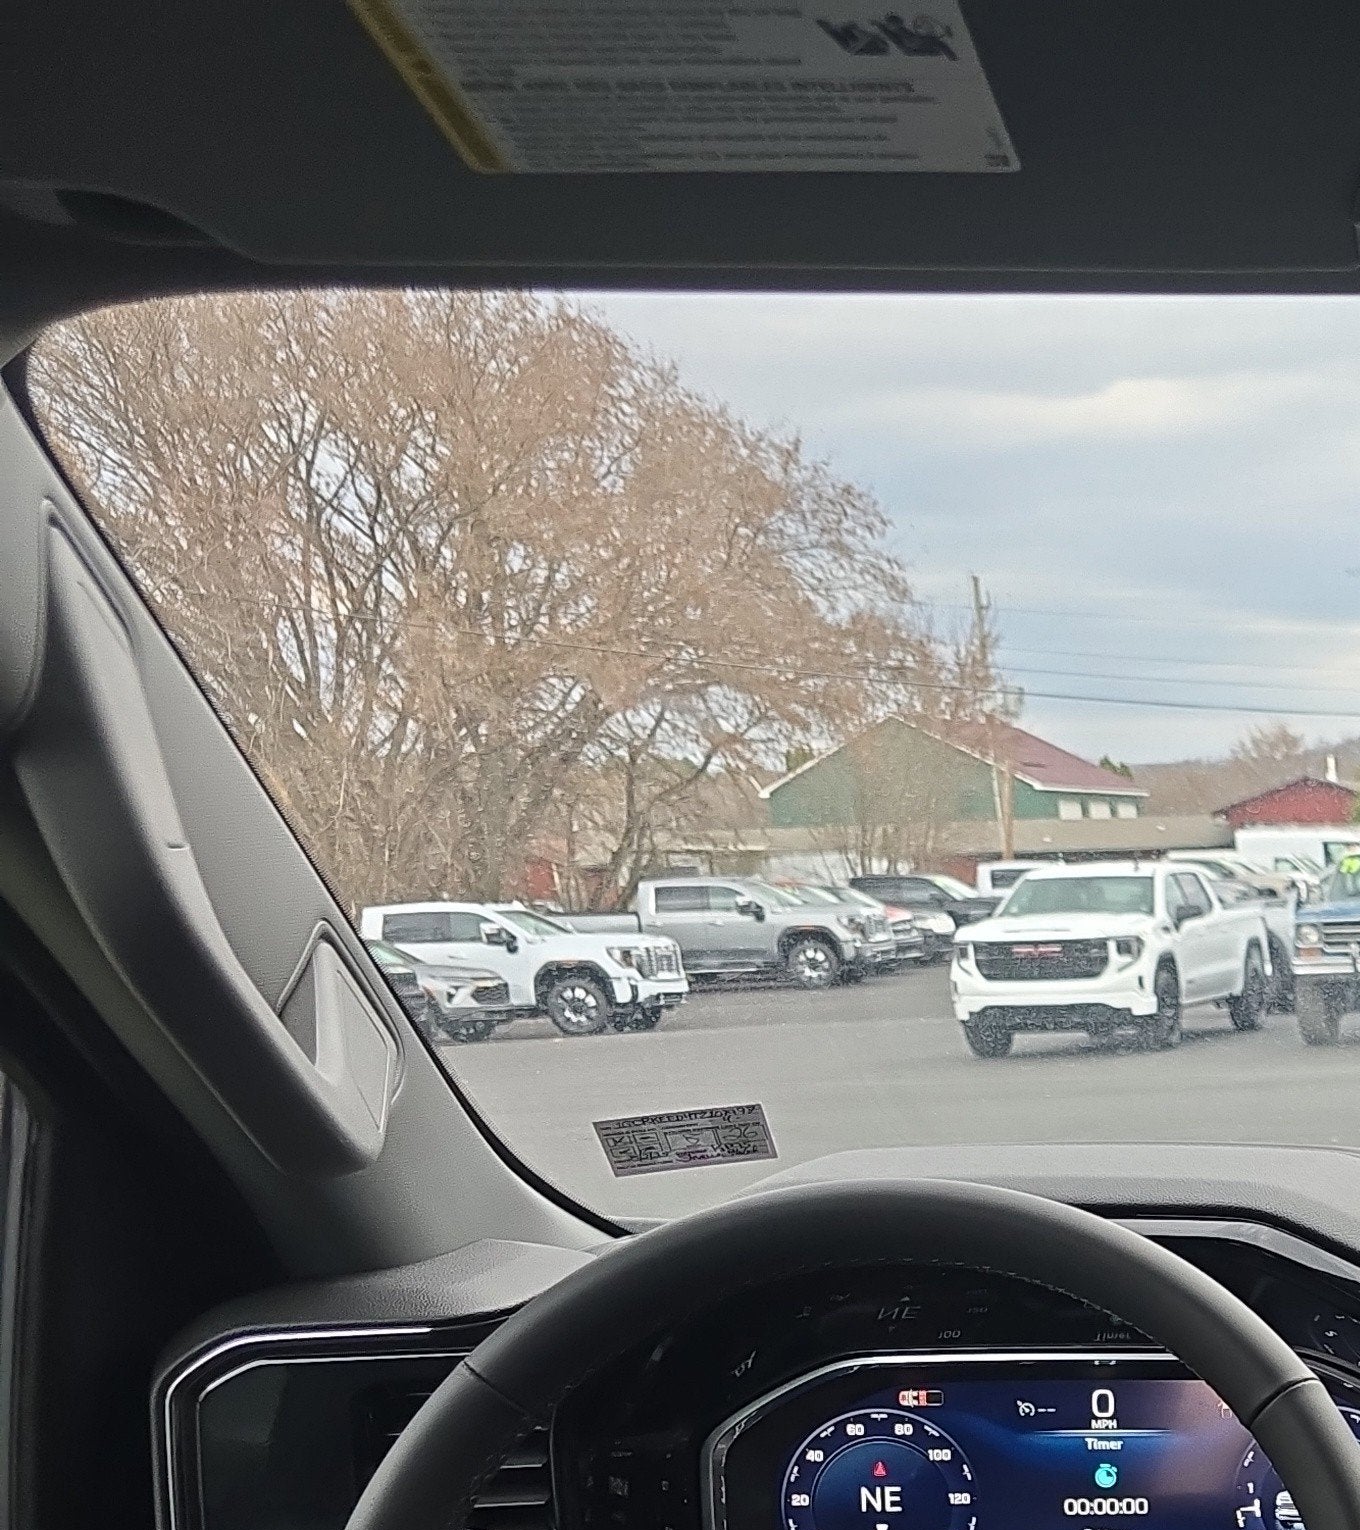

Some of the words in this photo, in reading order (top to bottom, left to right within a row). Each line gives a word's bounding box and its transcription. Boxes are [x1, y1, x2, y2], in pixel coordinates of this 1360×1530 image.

[1092, 1389, 1114, 1418] 0
[845, 1424, 865, 1436] 60
[894, 1424, 913, 1436] 80
[1091, 1419, 1118, 1429] MPH
[1085, 1438, 1123, 1451] Timer
[806, 1450, 824, 1462] 40
[928, 1449, 952, 1461] 100
[791, 1494, 810, 1506] 20
[860, 1486, 903, 1513] NE
[948, 1493, 971, 1504] 120
[1063, 1498, 1149, 1516] 00:00:00
